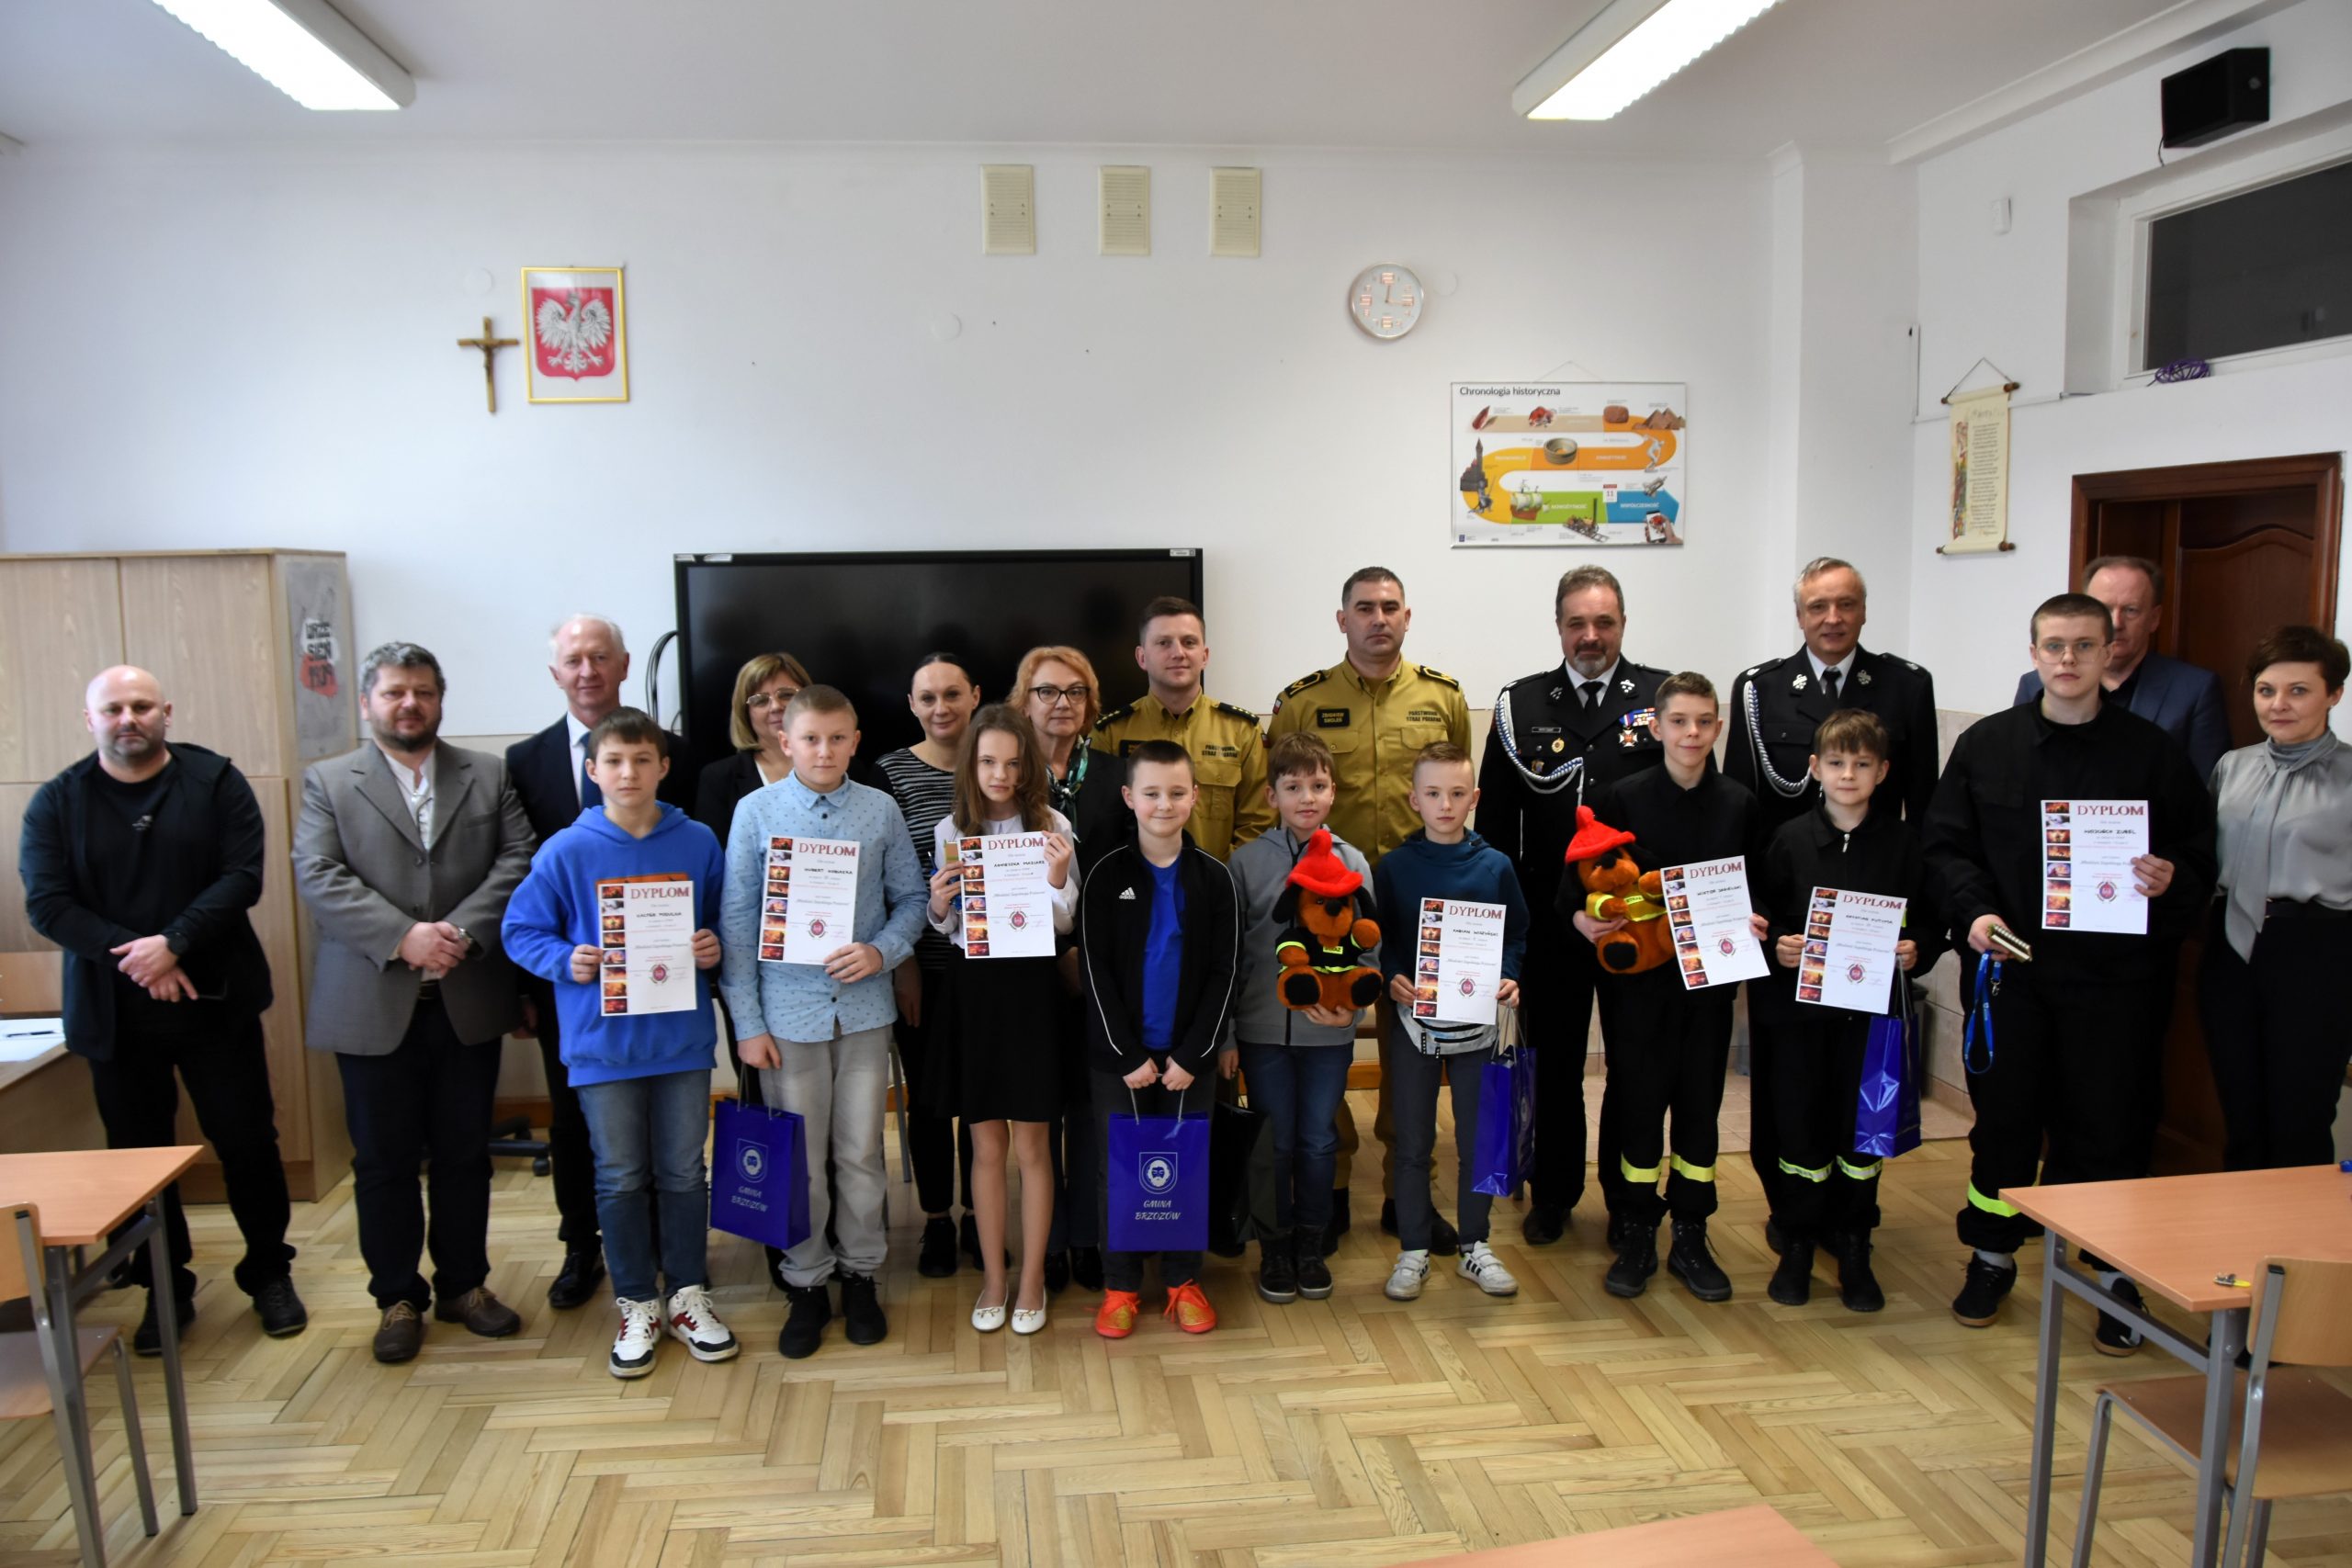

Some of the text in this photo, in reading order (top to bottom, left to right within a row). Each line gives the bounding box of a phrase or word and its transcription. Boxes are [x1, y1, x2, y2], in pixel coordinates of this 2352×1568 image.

[1459, 386, 1561, 397] Chronologia historyczna
[2077, 806, 2143, 816] DYPLOM
[798, 842, 856, 857] DYPLOM
[989, 837, 1044, 851] DYPLOM
[1690, 861, 1742, 879] DYPLOM
[630, 886, 690, 899] DYPLOM
[1843, 894, 1903, 910] DYPLOM
[1449, 905, 1503, 919] DYPLOM
[1143, 1200, 1171, 1208] GMINA
[1134, 1210, 1182, 1221] BRZOZÓW
